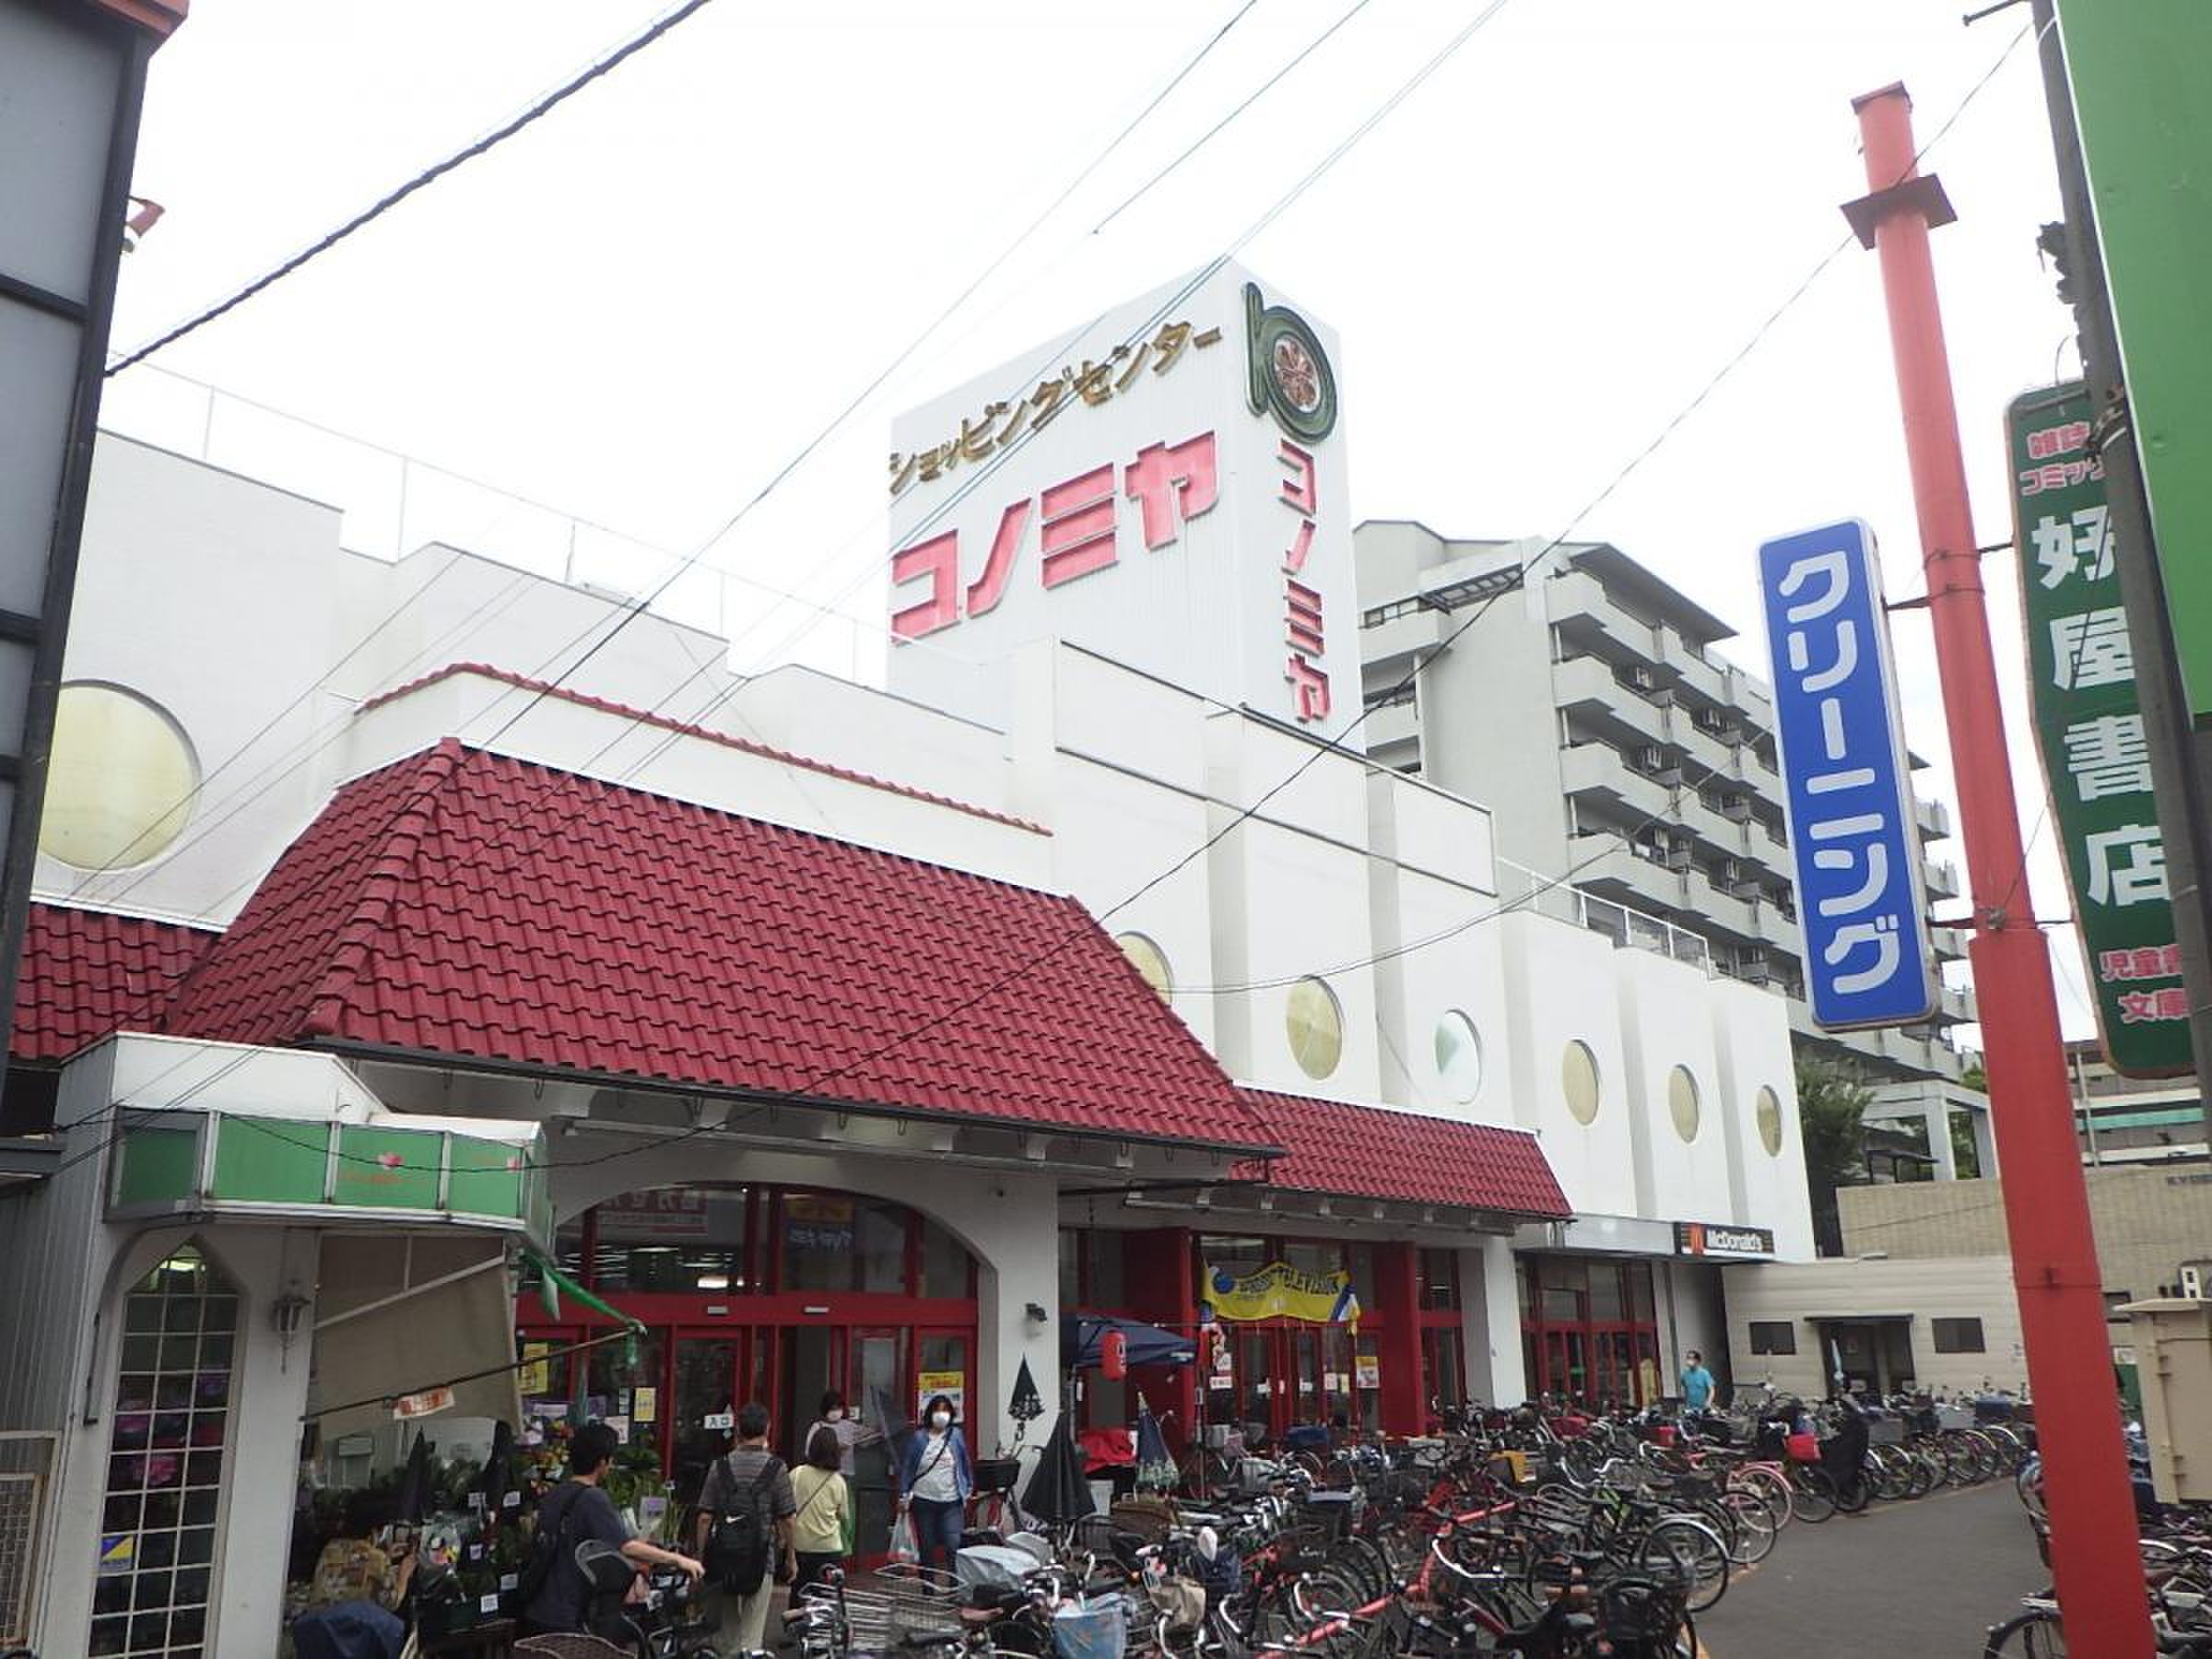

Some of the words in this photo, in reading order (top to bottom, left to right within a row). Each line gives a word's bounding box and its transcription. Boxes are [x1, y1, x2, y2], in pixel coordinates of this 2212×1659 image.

[890, 430, 1218, 646] コノミヤ
[1277, 438, 1331, 724] コノミヤ
[2031, 504, 2171, 907] 好屋書店
[1779, 550, 1900, 994] クリーニング
